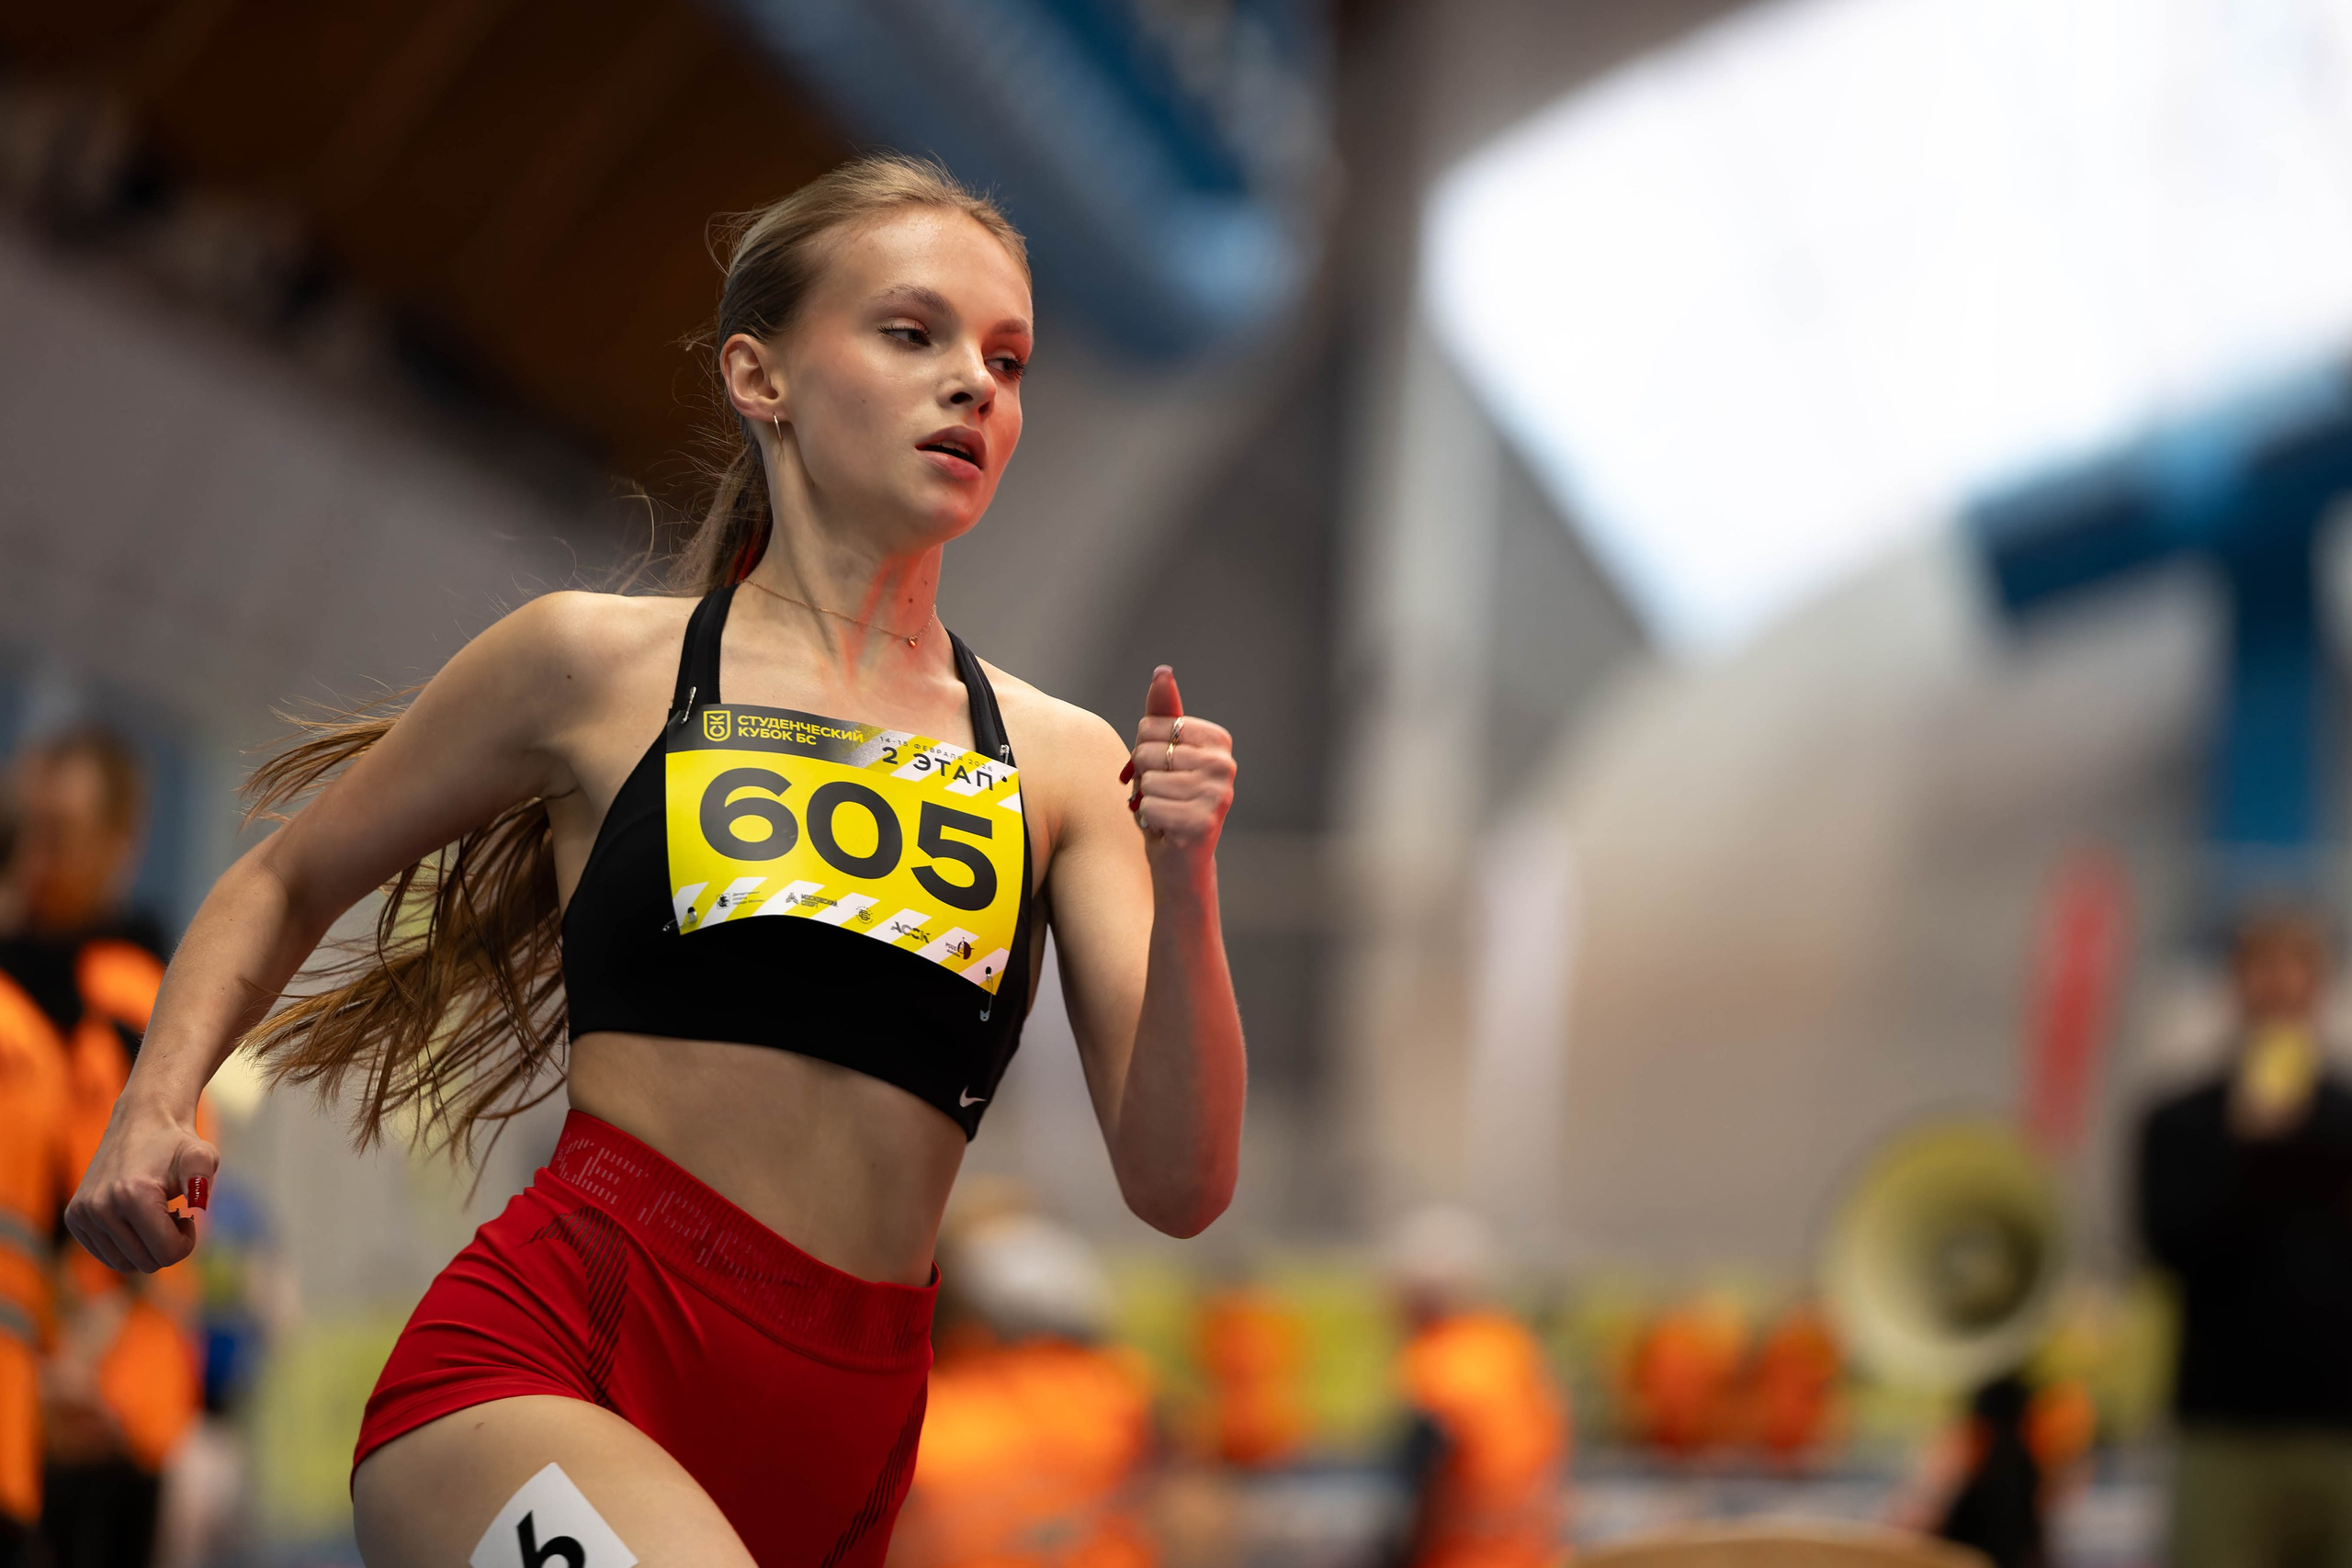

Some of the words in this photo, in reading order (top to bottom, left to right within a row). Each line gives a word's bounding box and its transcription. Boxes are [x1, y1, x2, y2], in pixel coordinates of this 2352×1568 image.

[738, 715, 864, 743] СТУДЕНЧЕСКИЙ
[738, 727, 793, 742] КУБОК
[796, 733, 817, 745] БС
[914, 743, 963, 761] ФЕВРАЛЯ
[882, 746, 899, 765] 2
[912, 752, 994, 791] ЭТАП
[699, 767, 998, 912] 605
